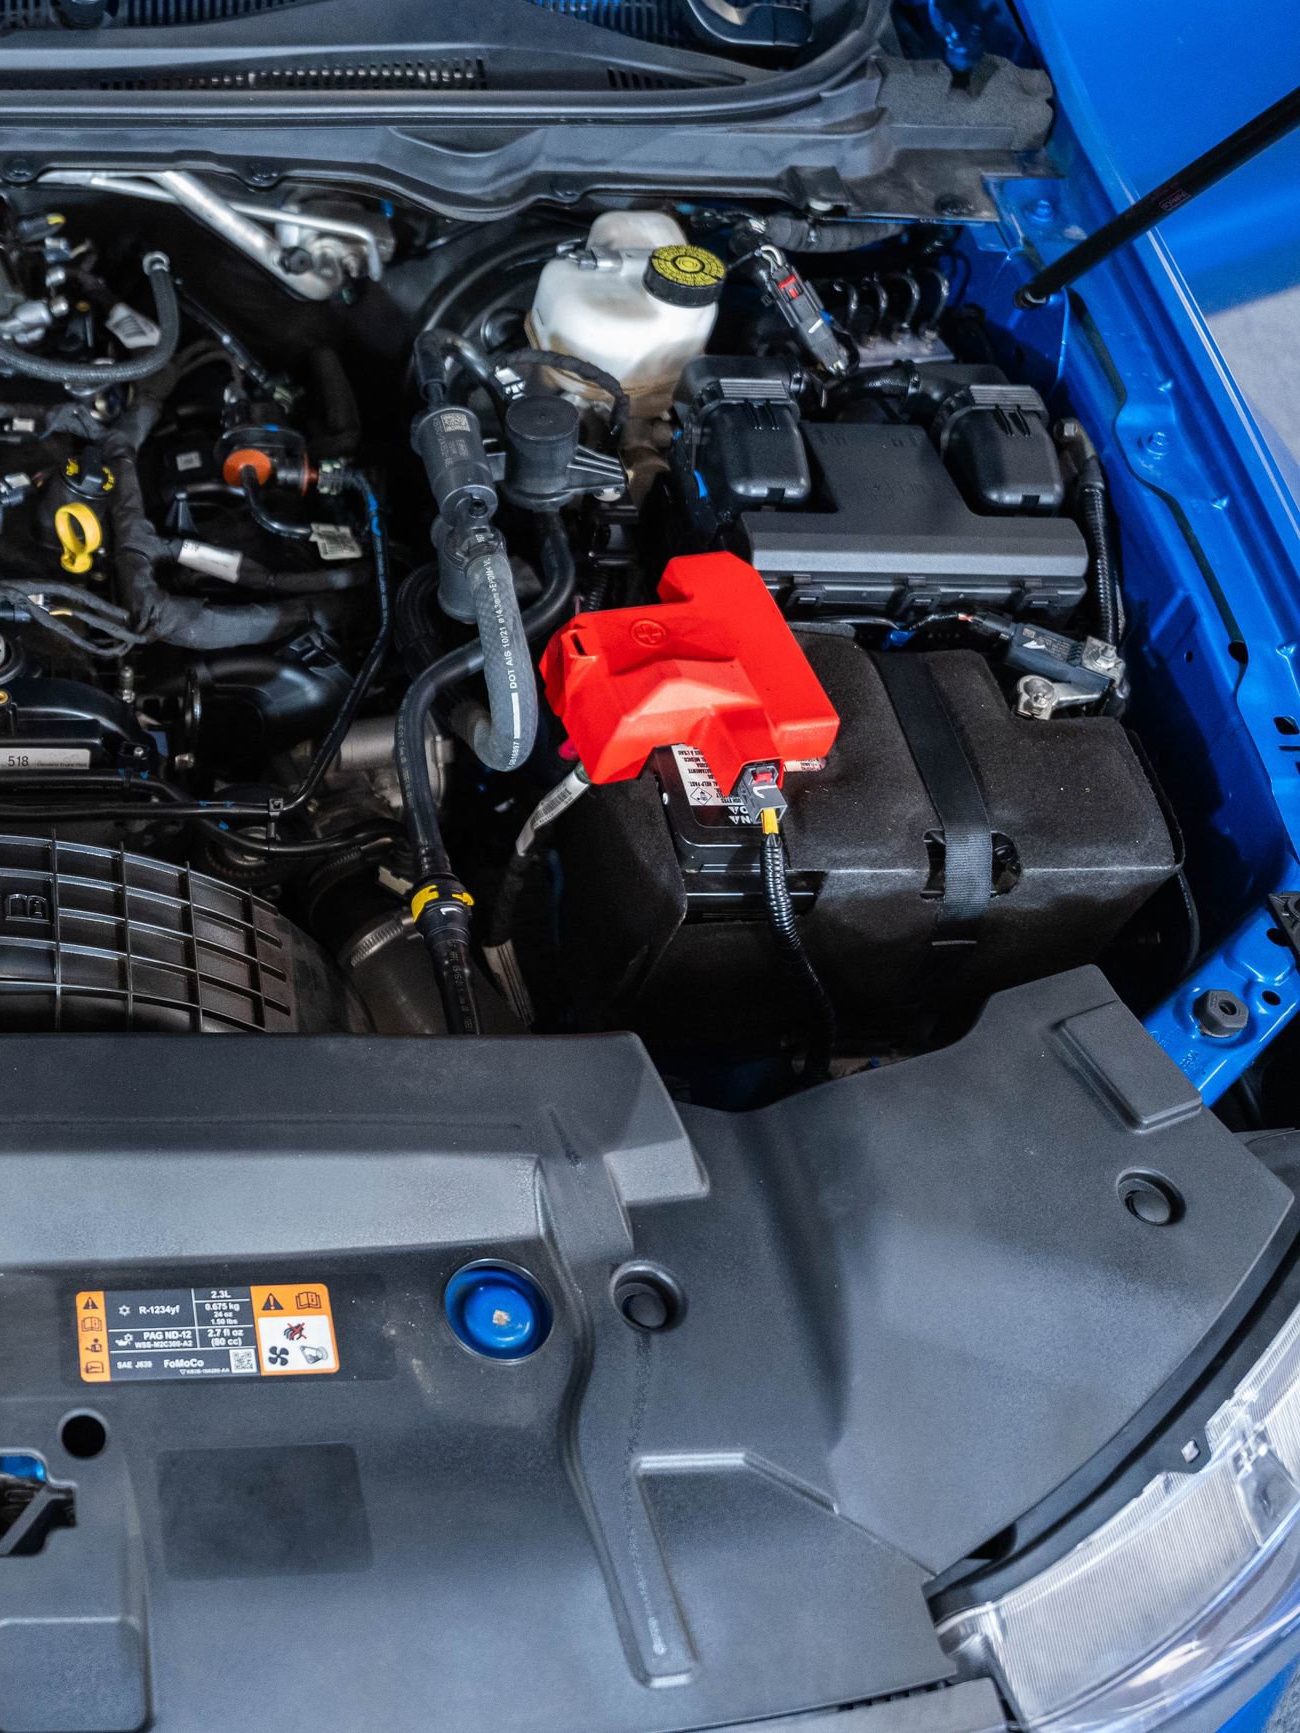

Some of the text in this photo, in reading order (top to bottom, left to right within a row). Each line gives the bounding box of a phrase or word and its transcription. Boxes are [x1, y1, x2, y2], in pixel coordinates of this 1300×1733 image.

[499, 626, 510, 648] 10/21
[504, 650, 514, 666] AIS
[508, 669, 518, 689] DOT
[8, 756, 29, 767] 518
[210, 1290, 231, 1298] 2.3L
[139, 1304, 180, 1315] R-1234yf
[205, 1302, 240, 1311] 0.675 kg
[143, 1331, 192, 1340] PAG ND-12
[207, 1328, 244, 1337] 2.7 fl oz
[211, 1336, 242, 1347] (80 cc)
[117, 1361, 133, 1369] SAE
[163, 1359, 204, 1368] FoMoCo
